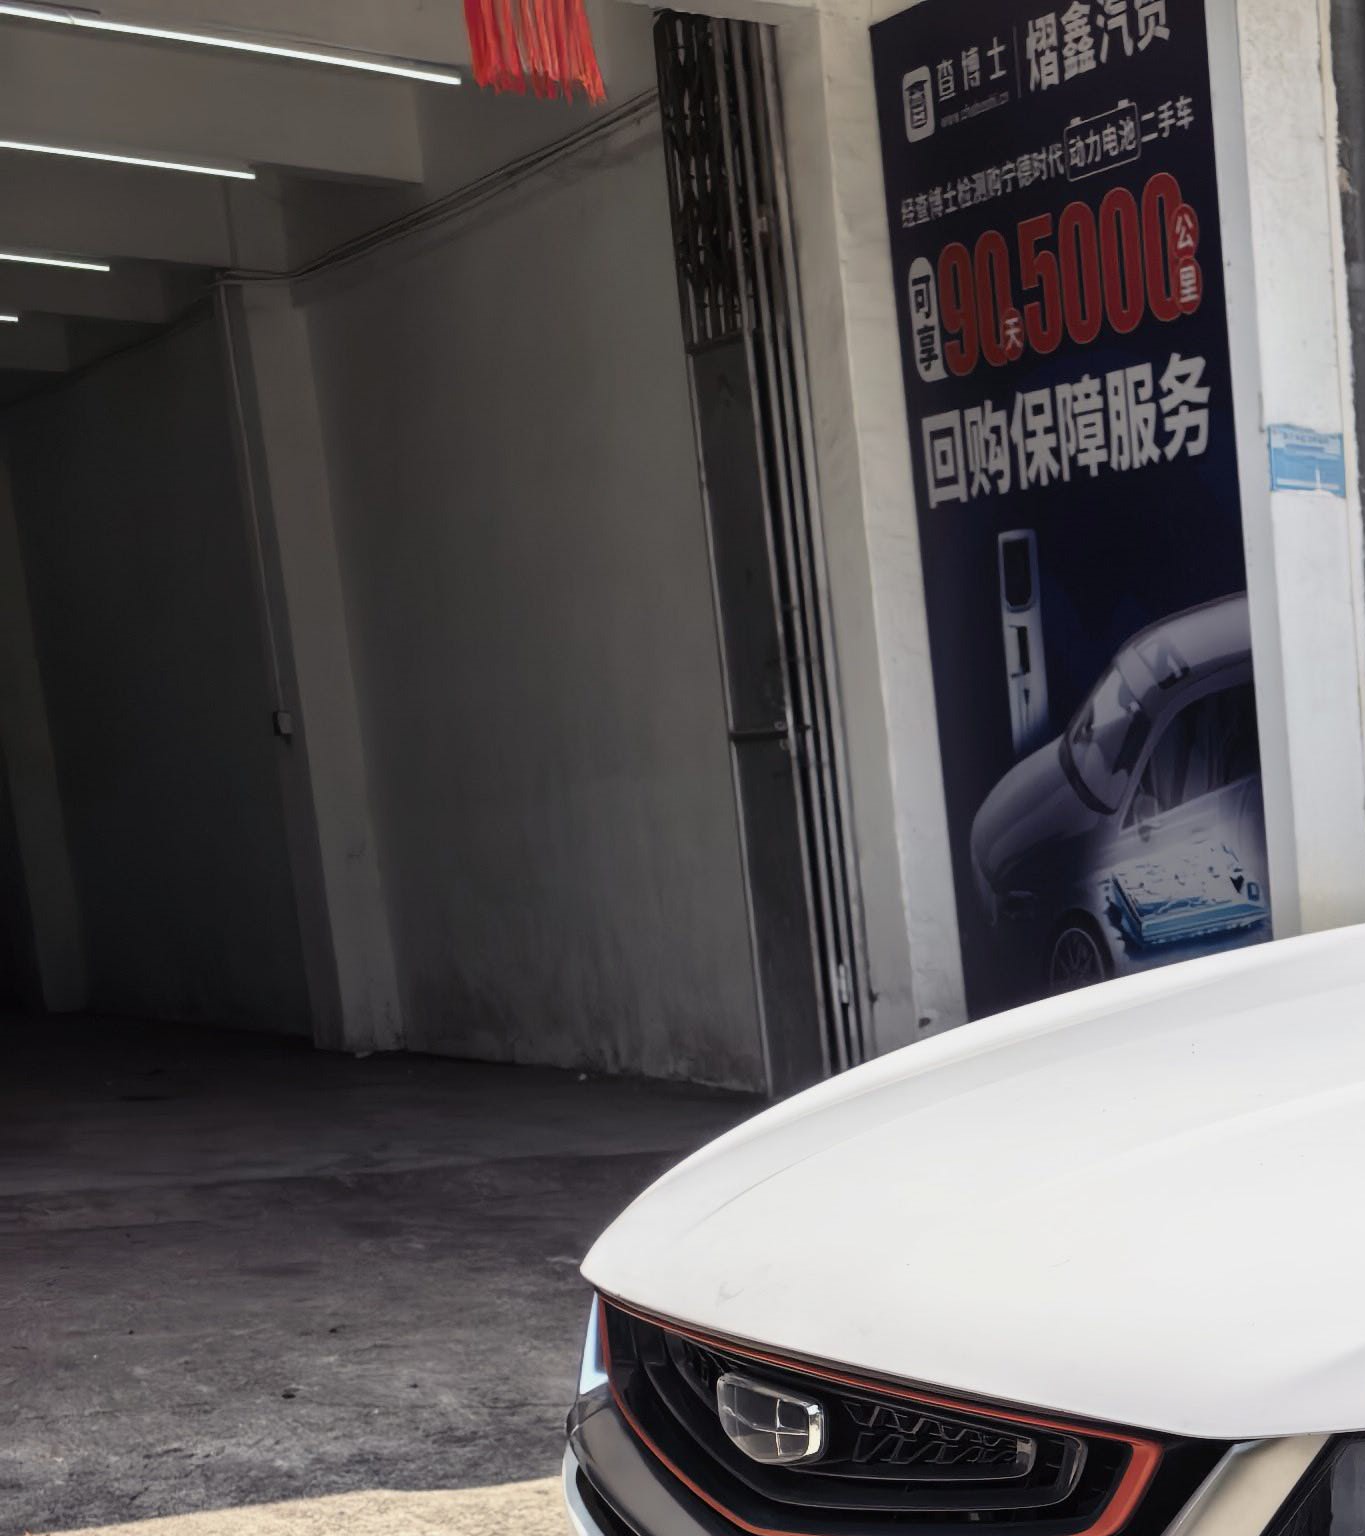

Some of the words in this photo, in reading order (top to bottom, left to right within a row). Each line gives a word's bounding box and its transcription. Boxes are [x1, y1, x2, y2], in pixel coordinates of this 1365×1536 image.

[937, 229, 1014, 377] 90
[1017, 171, 1186, 354] 5000
[922, 353, 1212, 509] 回购保障服务
